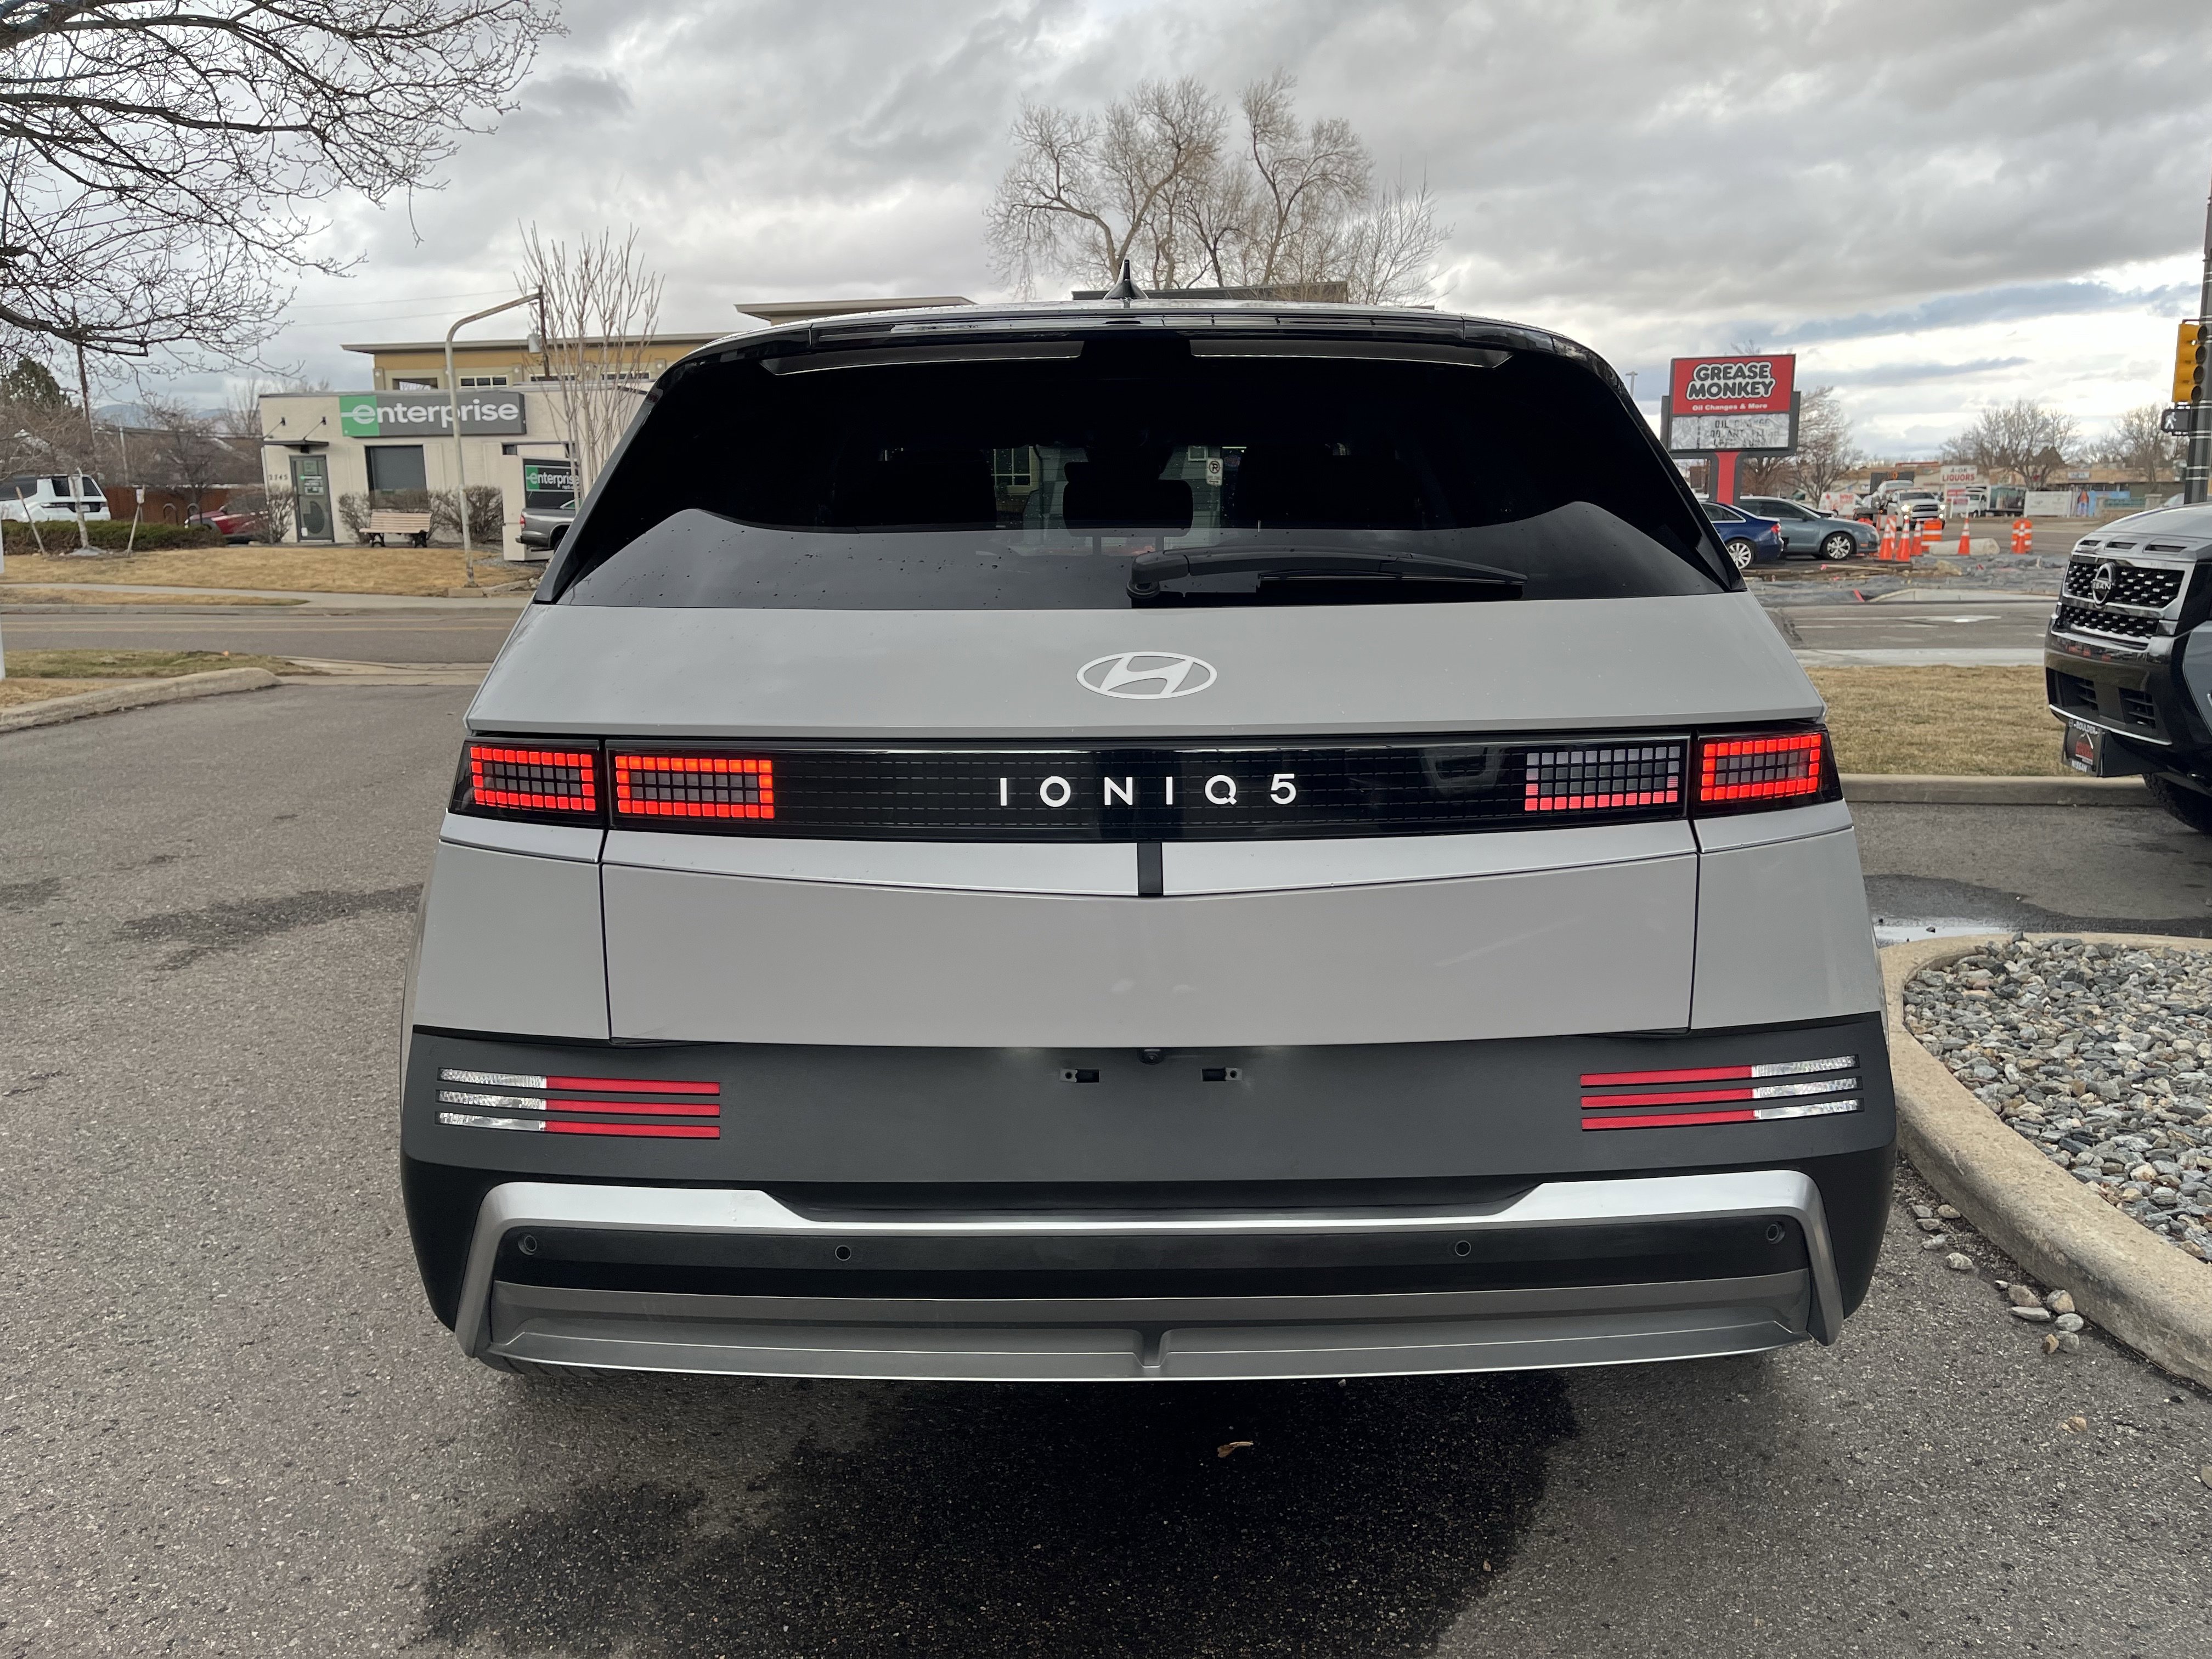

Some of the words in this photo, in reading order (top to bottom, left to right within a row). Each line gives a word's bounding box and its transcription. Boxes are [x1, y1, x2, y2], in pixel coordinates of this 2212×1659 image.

[1696, 364, 1770, 381] GREASE
[1689, 381, 1774, 398] MONKEY
[341, 399, 519, 428] enterprise
[1943, 473, 1975, 482] LIQUORS
[1000, 774, 1238, 808] IONIQ
[1269, 773, 1297, 805] 5
